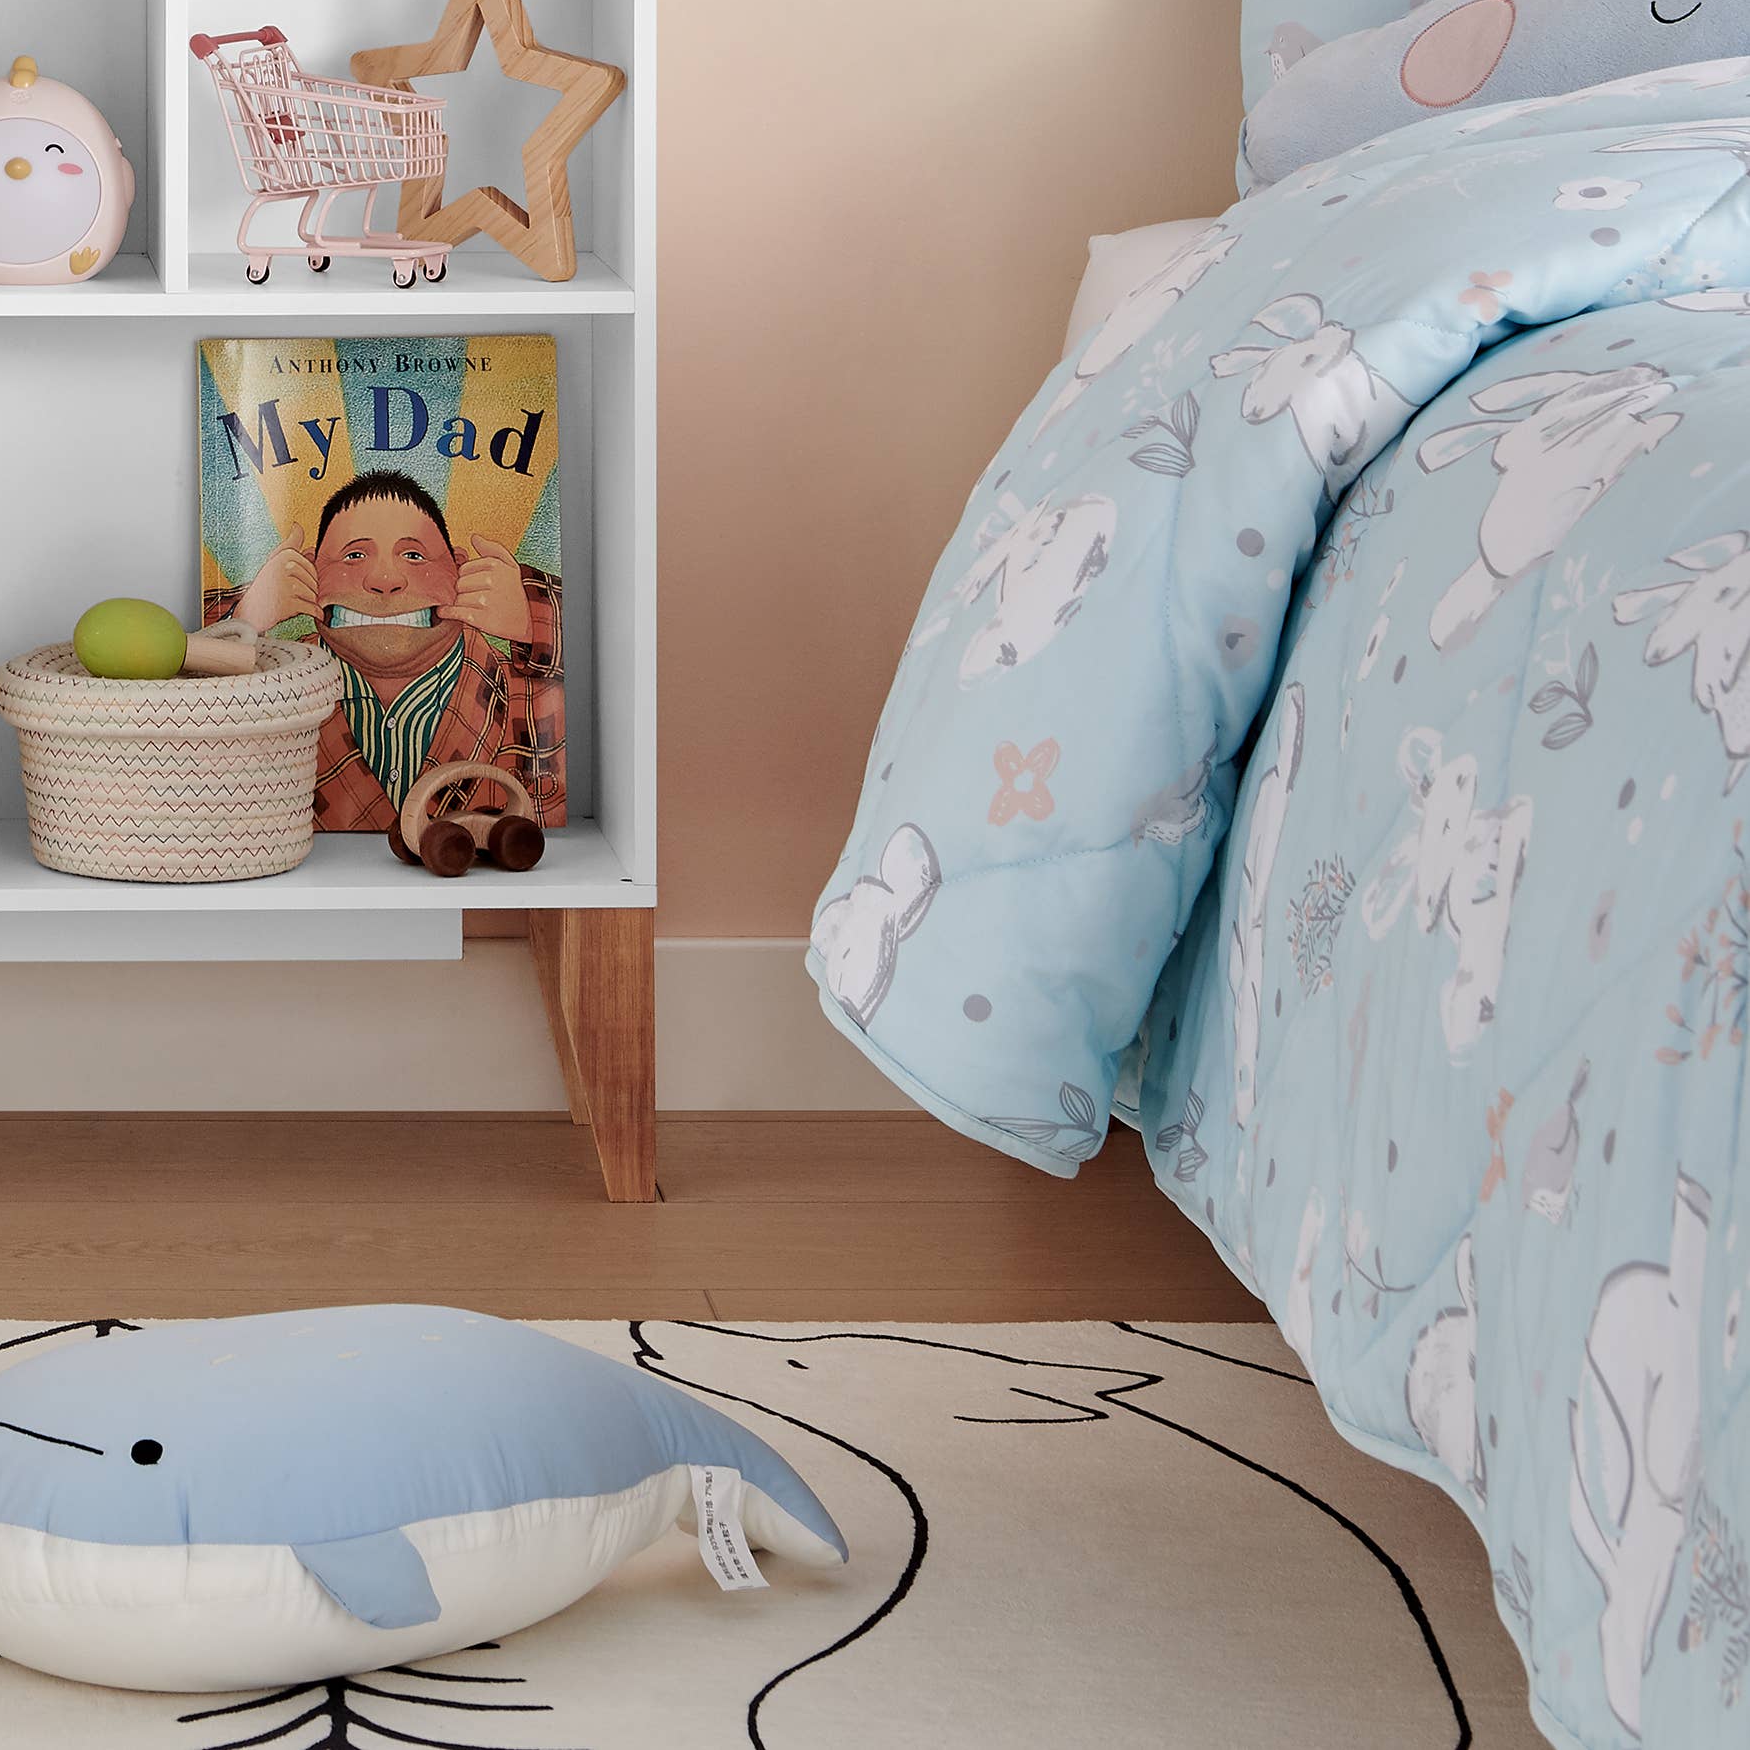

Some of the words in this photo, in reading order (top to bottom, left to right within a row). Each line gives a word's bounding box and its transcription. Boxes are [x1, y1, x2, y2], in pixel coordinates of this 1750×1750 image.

[269, 354, 379, 374] ANTHONY
[396, 354, 493, 373] BROWNE
[217, 399, 341, 481] My
[364, 386, 545, 478] Dad
